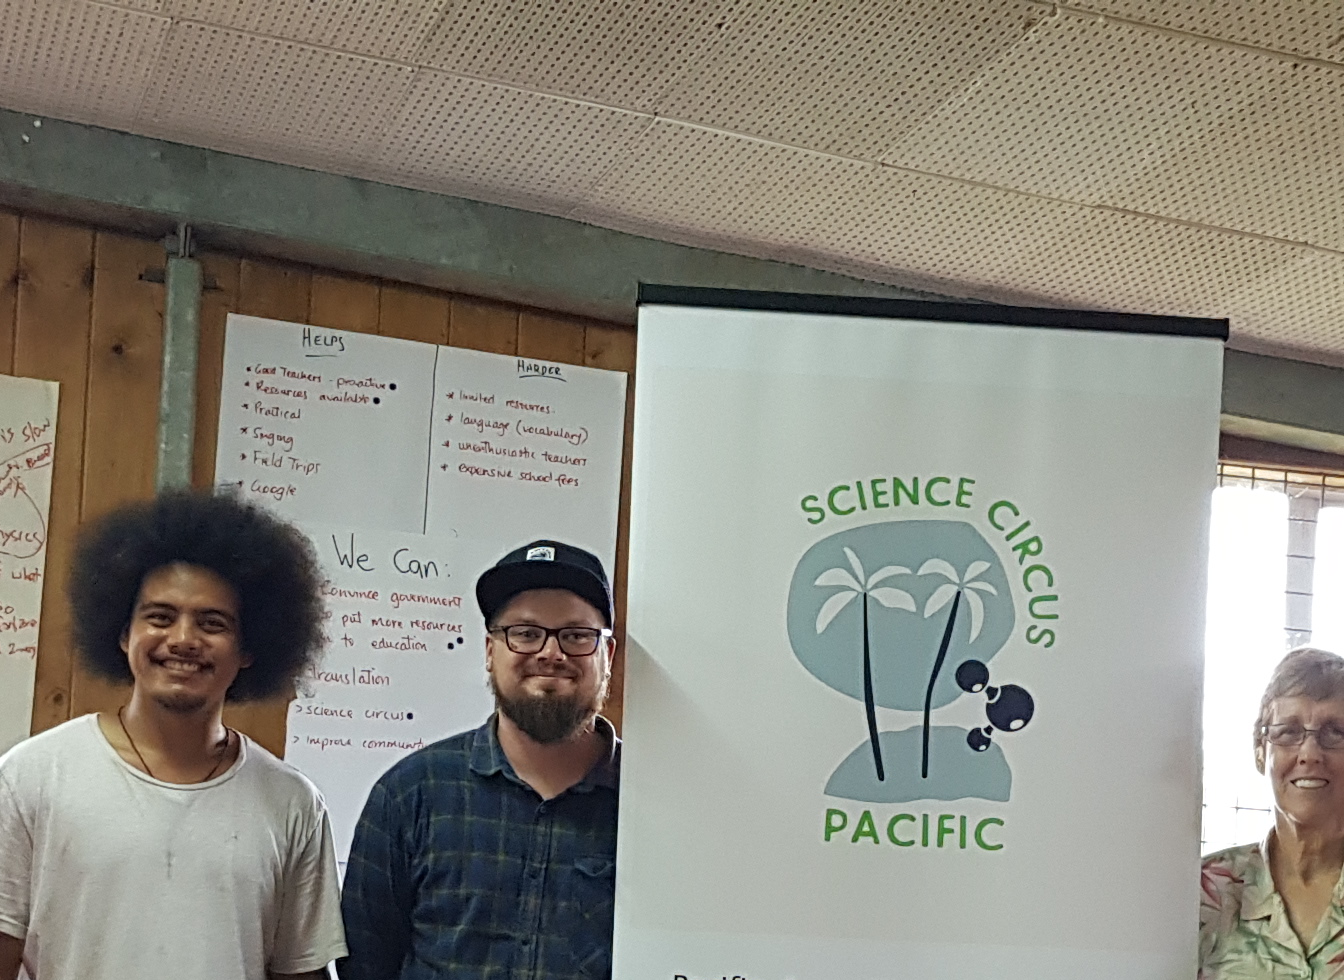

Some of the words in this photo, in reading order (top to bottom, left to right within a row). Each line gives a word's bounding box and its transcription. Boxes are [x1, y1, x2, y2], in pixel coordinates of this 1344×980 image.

[302, 327, 345, 351] HELPS
[517, 359, 561, 376] HARDER
[460, 412, 510, 437] language
[253, 451, 283, 469] Field
[288, 456, 322, 476] Trips
[250, 479, 297, 501] Google
[332, 532, 375, 572] We
[800, 476, 976, 525] SCIENCE
[987, 500, 1060, 649] CIRCUS
[341, 611, 362, 628] put
[371, 617, 404, 630] more
[410, 618, 463, 634] resources
[371, 634, 428, 652] education
[306, 703, 353, 719] science
[364, 707, 404, 721] circus
[823, 808, 1005, 851] PACIFIC
